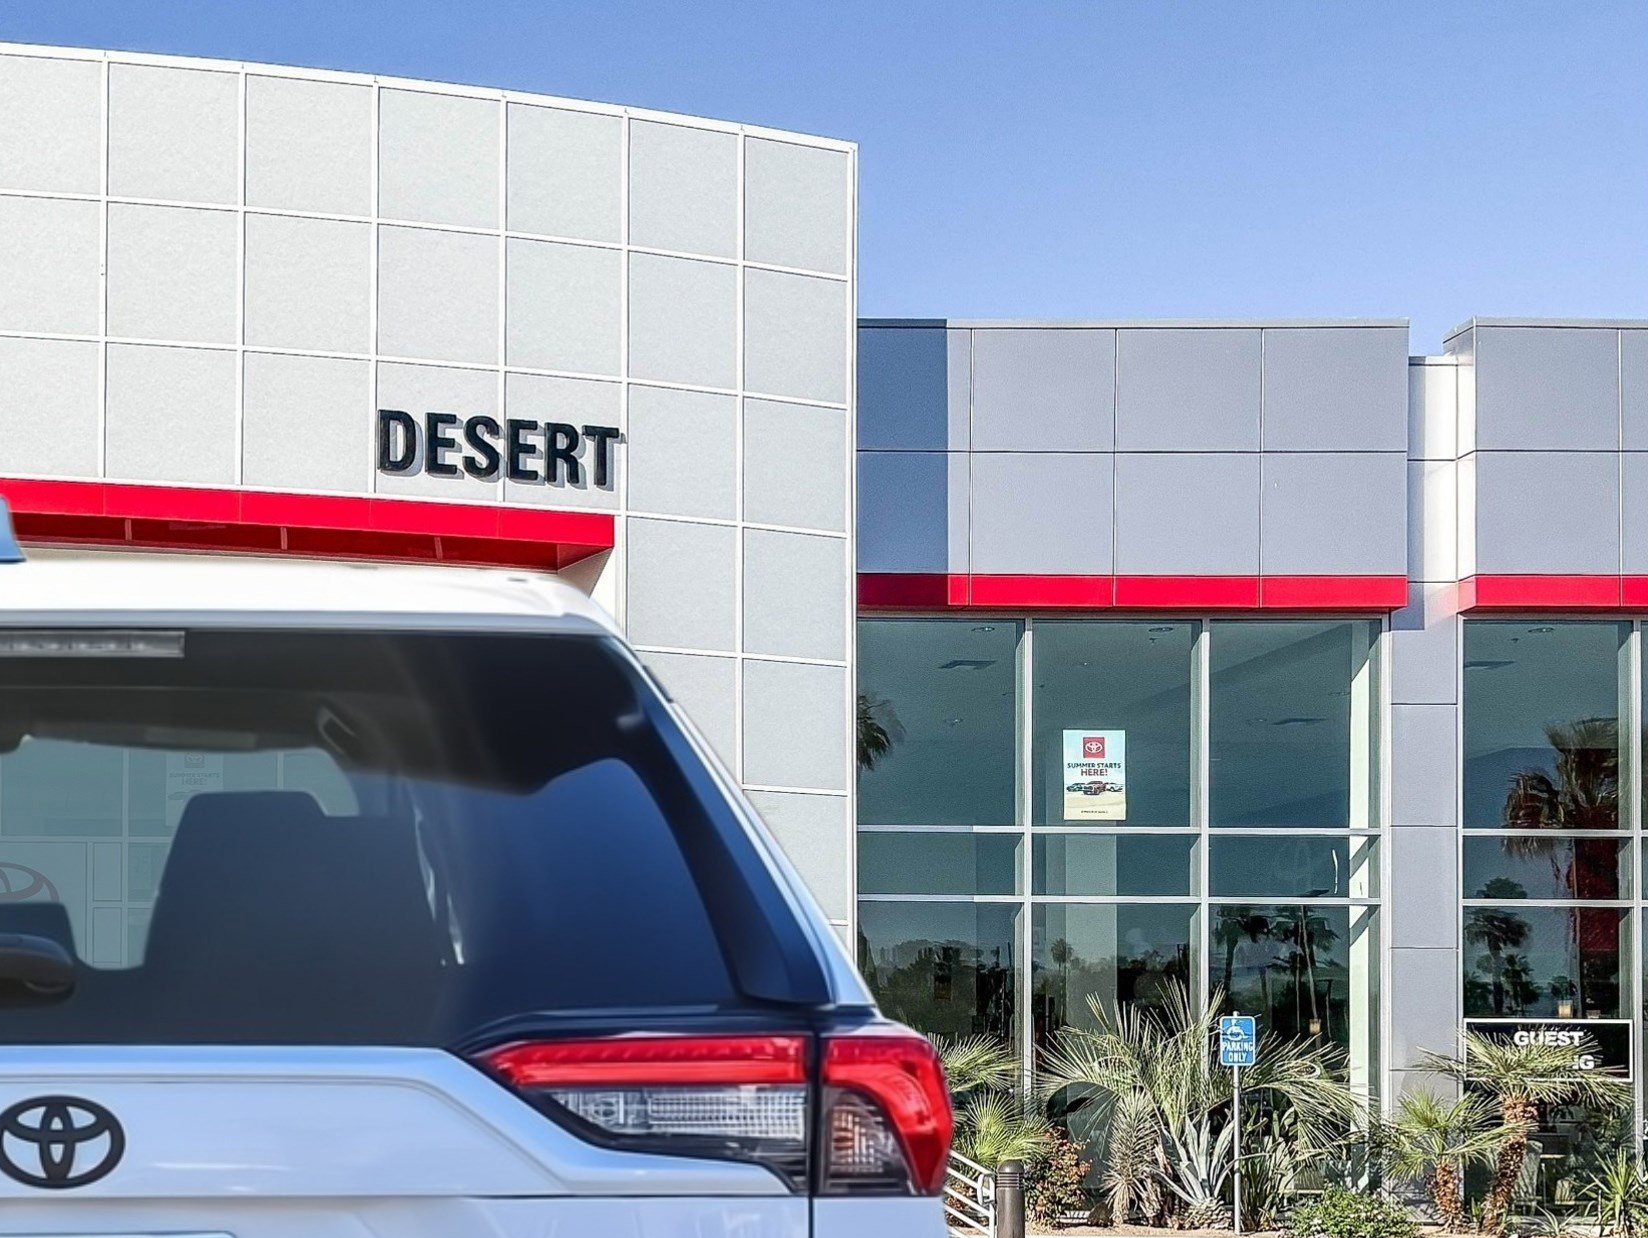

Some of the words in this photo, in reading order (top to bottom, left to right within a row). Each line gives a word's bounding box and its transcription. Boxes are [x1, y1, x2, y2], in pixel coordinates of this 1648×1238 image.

[376, 409, 620, 486] DESERT
[1081, 768, 1108, 776] HERE!
[1513, 1031, 1584, 1046] GUEST
[1222, 1041, 1253, 1052] PARKING
[1228, 1052, 1247, 1063] ONLY
